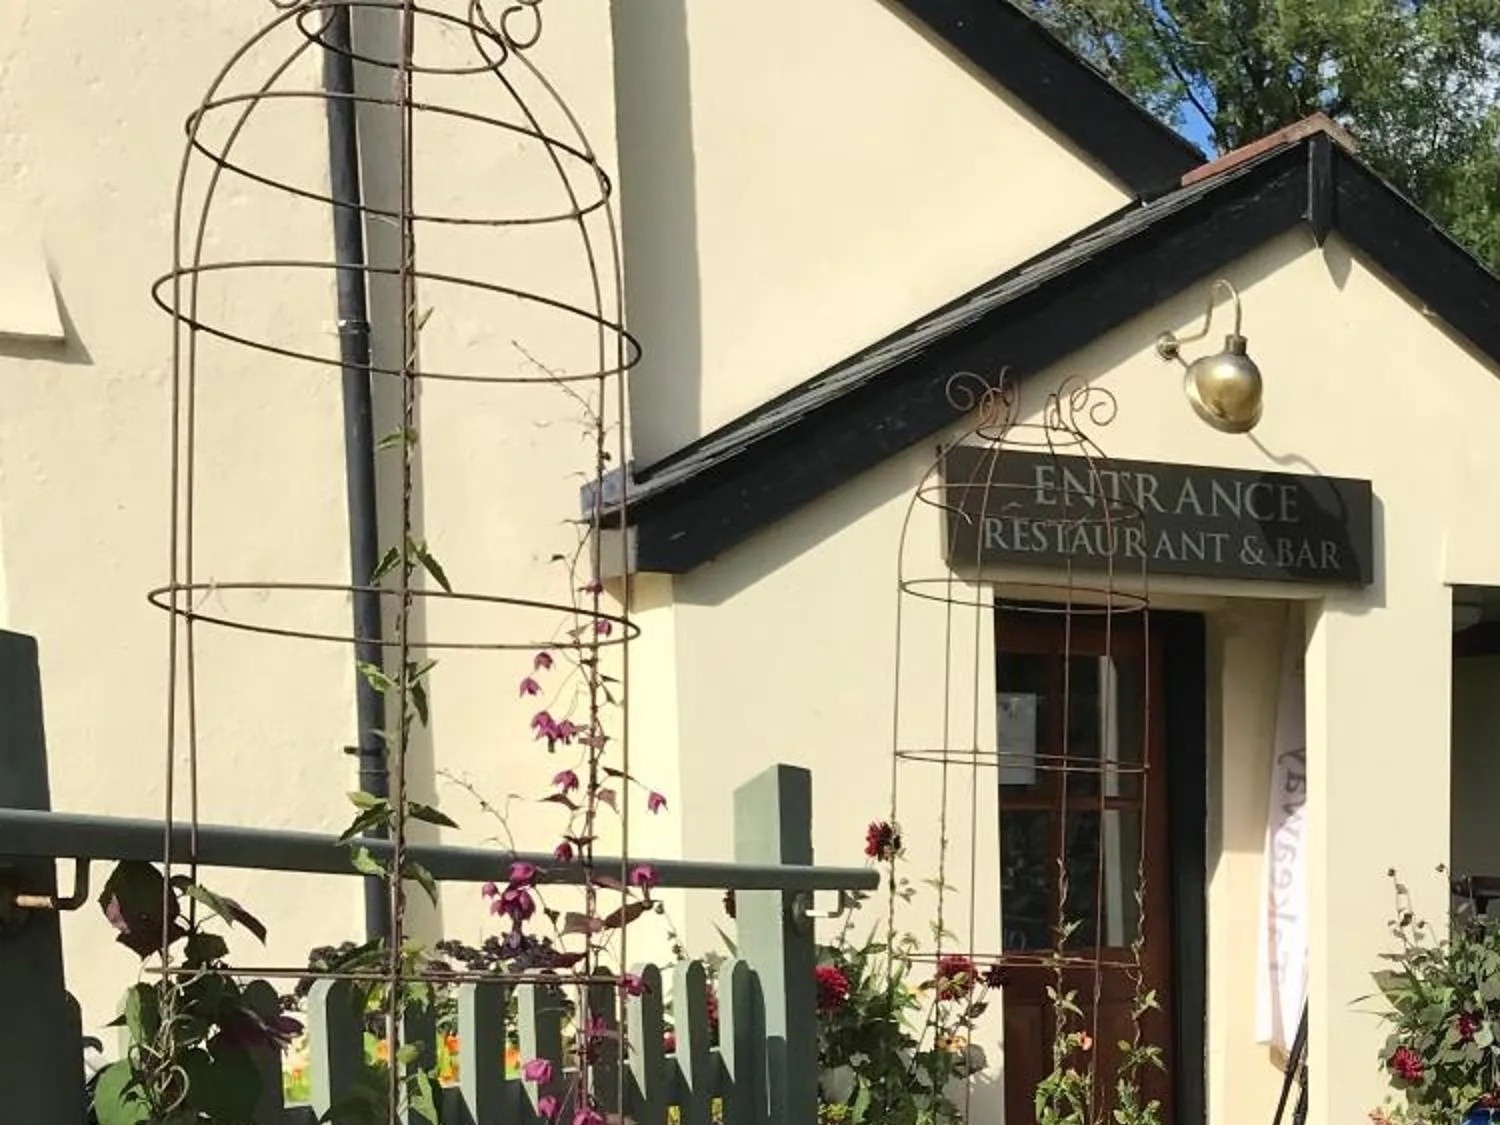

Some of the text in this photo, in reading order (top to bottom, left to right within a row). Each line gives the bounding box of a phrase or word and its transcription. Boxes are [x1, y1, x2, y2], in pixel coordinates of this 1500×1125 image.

[1034, 466, 1298, 522] ENTRANCE
[984, 518, 1341, 570] RESTAURANT & BAR
